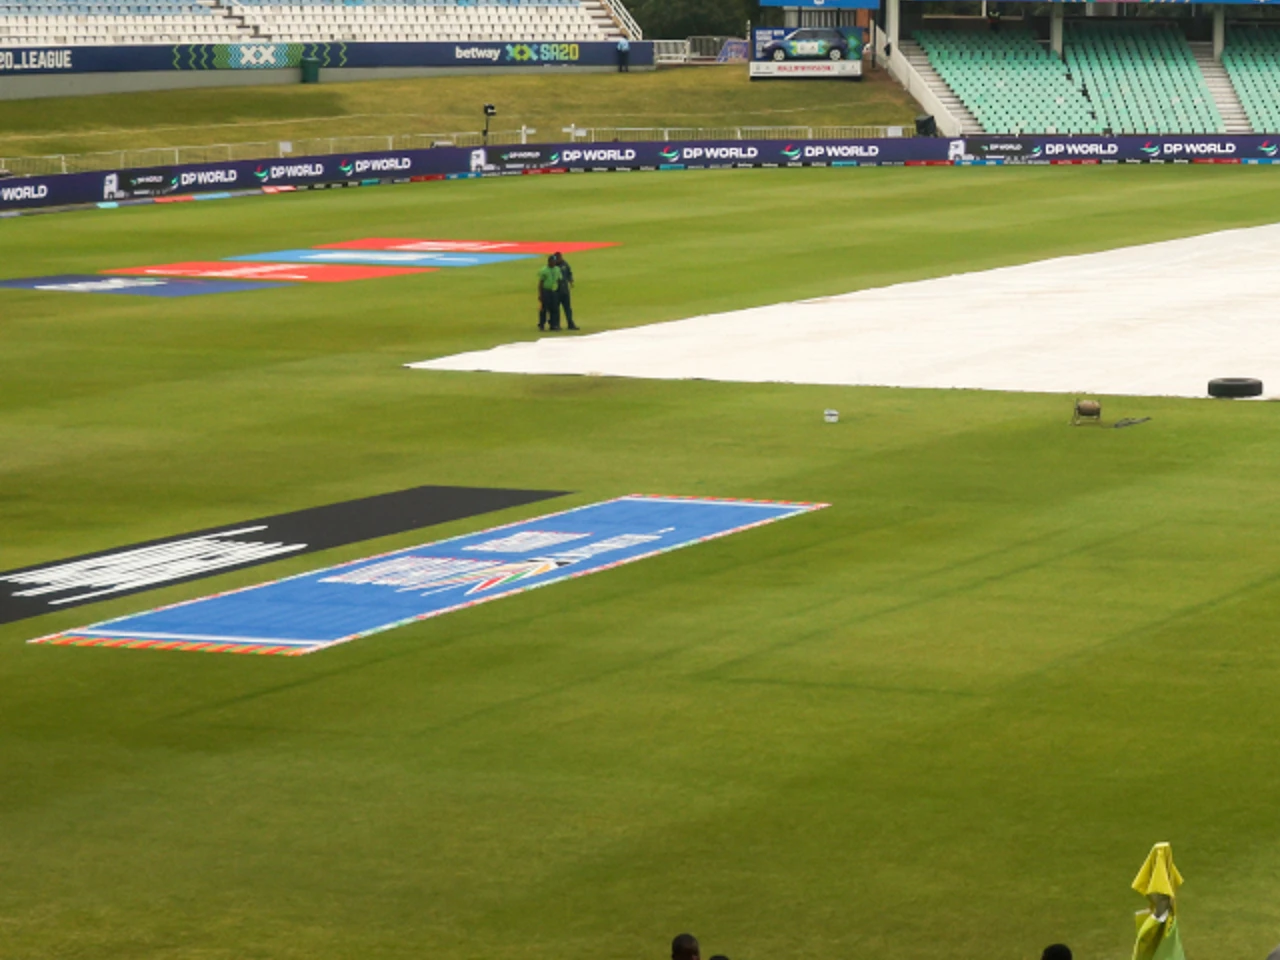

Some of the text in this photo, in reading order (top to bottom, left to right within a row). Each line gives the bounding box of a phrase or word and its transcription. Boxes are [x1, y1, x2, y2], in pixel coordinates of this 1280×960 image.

[455, 44, 501, 62] betway
[540, 43, 579, 61] SA20
[562, 149, 636, 162] DP WORLD
[683, 147, 759, 159] DP WORLD
[804, 145, 879, 158] DP WORLD
[1045, 143, 1119, 155] DP WORLD
[1163, 143, 1236, 154] DP WORLD
[270, 163, 324, 179] DP WORLD
[355, 157, 411, 173] DP WORLD
[181, 171, 195, 185] DP
[197, 169, 238, 184] WORLD
[2, 184, 48, 201] WORLD
